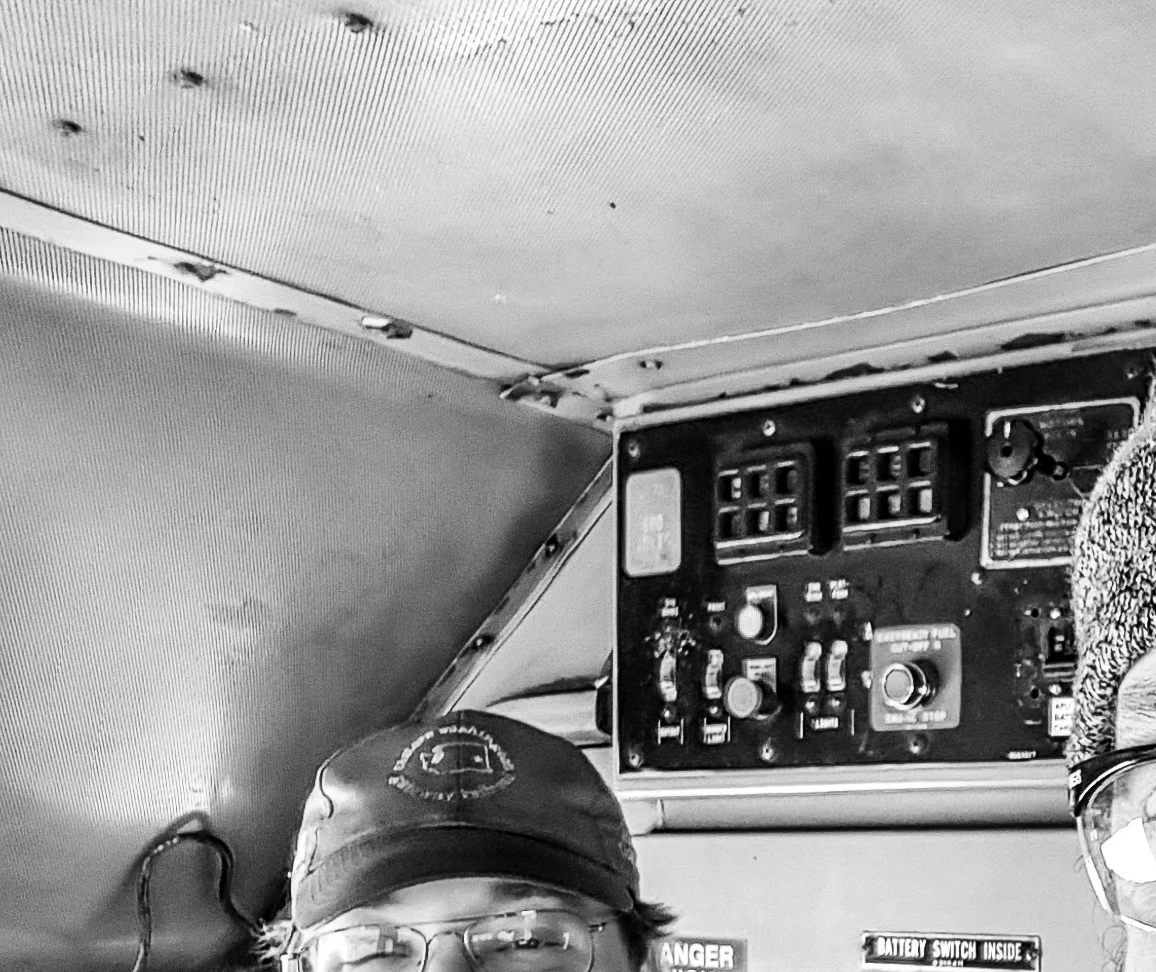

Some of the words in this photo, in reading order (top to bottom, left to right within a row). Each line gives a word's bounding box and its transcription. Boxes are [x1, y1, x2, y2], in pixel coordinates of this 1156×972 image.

[877, 936, 926, 958] BATTERY
[932, 939, 977, 959] SWITCH
[983, 941, 1022, 961] INSIDE
